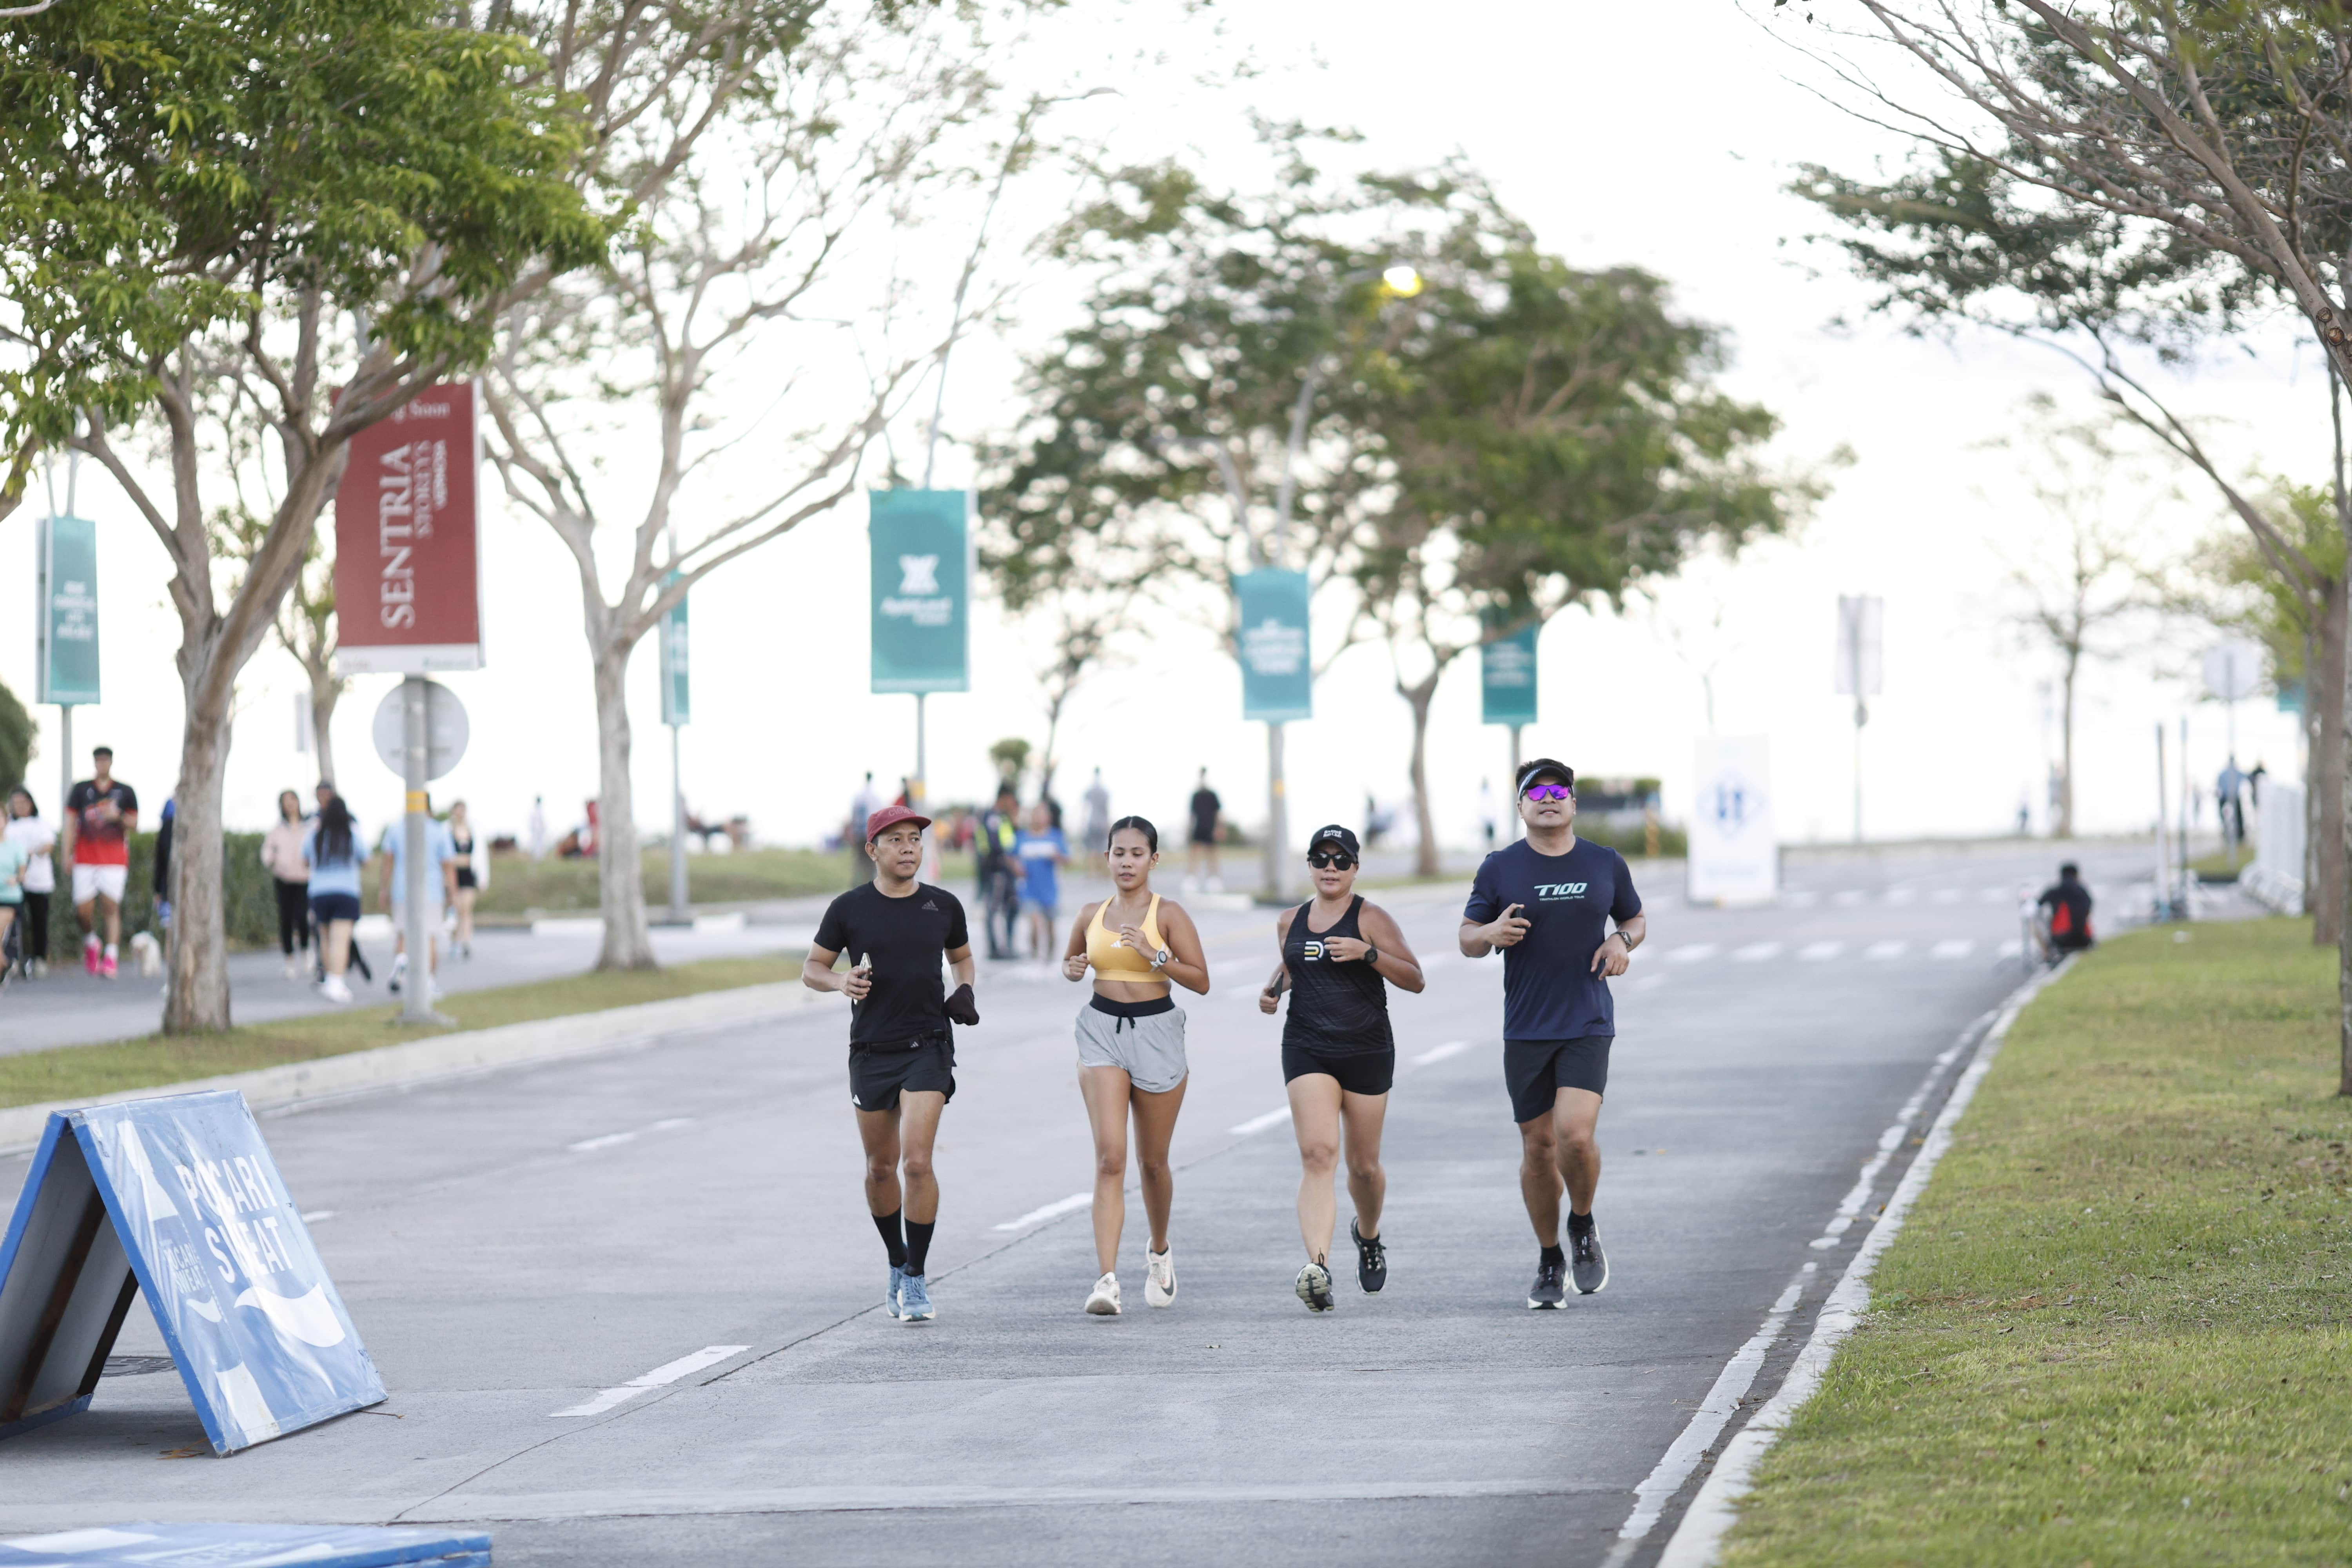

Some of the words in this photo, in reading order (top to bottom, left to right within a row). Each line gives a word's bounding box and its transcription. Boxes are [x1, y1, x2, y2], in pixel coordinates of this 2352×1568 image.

[379, 443, 416, 629] SENTRIA
[1534, 882, 1587, 896] T100
[175, 1154, 277, 1221] POCARI
[205, 1216, 293, 1283] SWEAT
